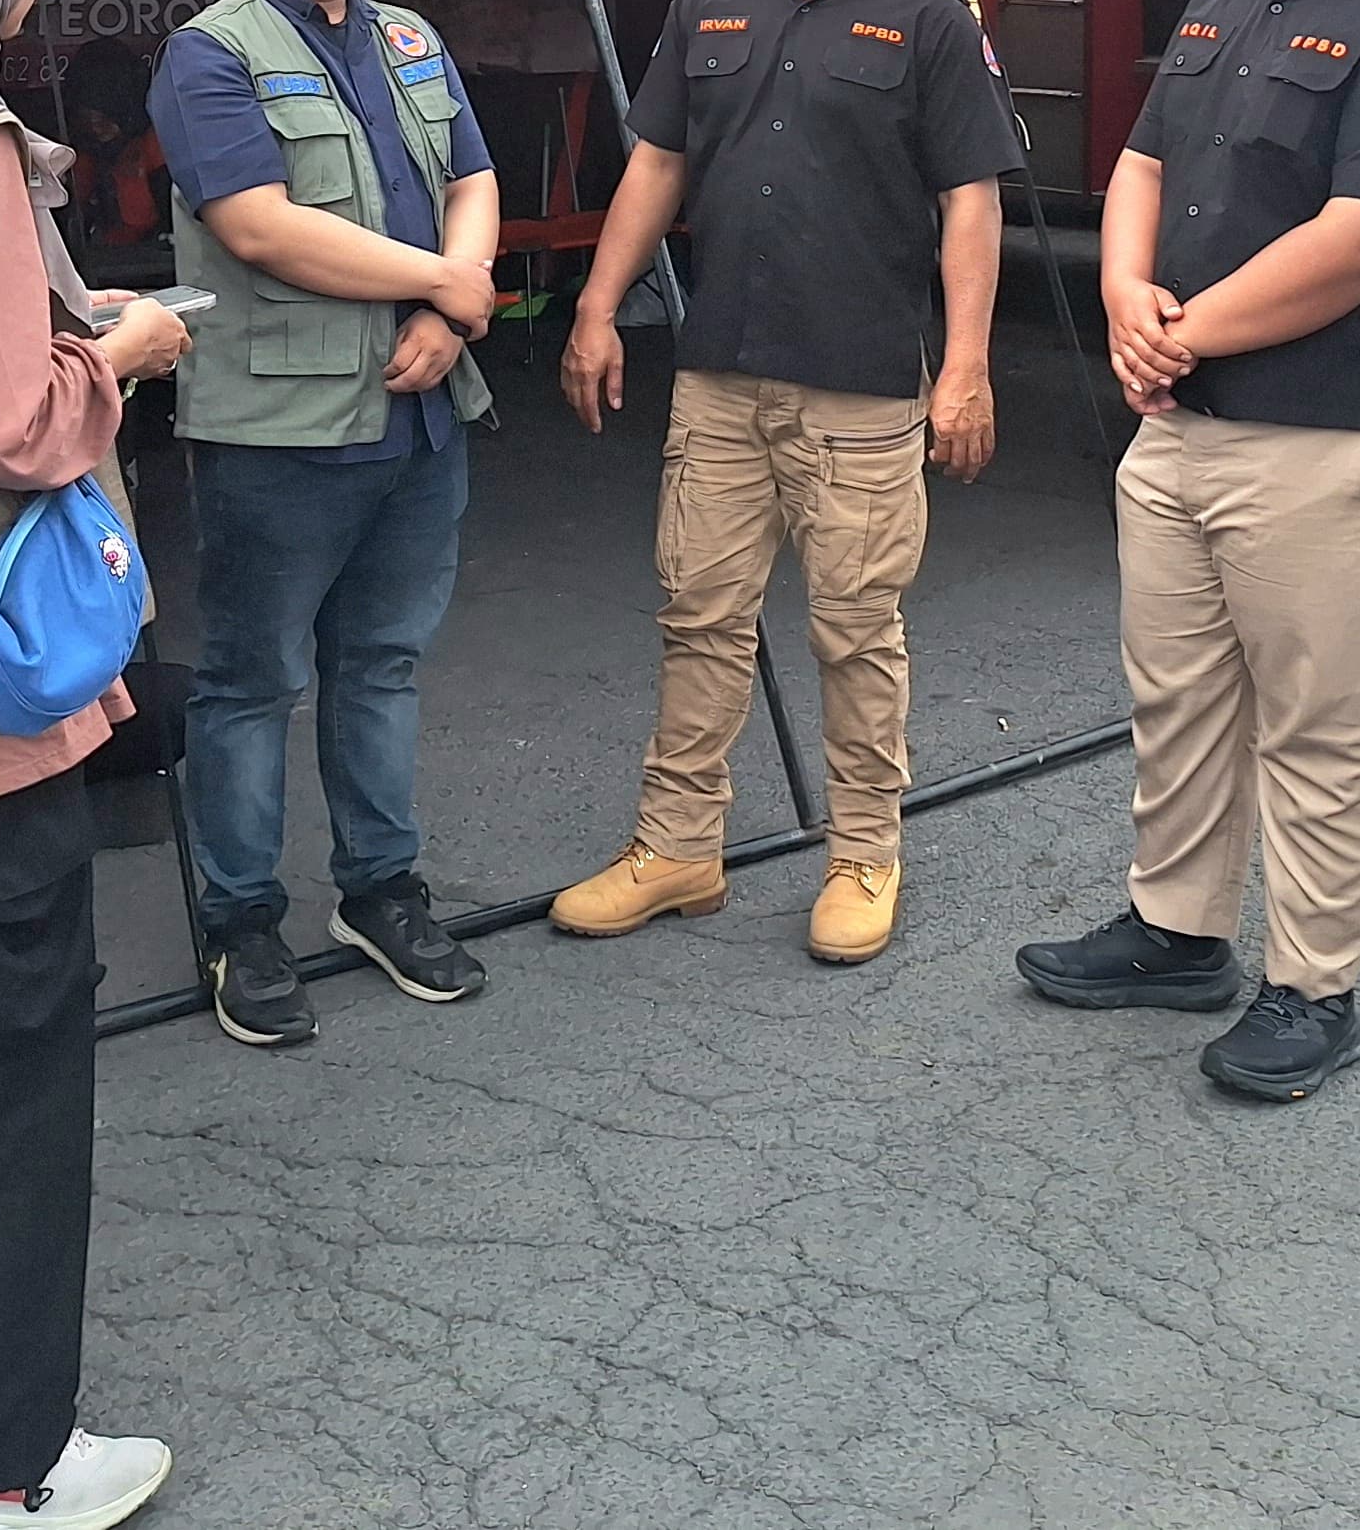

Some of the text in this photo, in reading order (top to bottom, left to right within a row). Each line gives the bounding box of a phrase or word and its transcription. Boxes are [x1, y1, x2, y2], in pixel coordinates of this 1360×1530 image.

[698, 18, 746, 33] IRVAN
[851, 22, 904, 44] BPBD
[1179, 23, 1218, 39] AQIL
